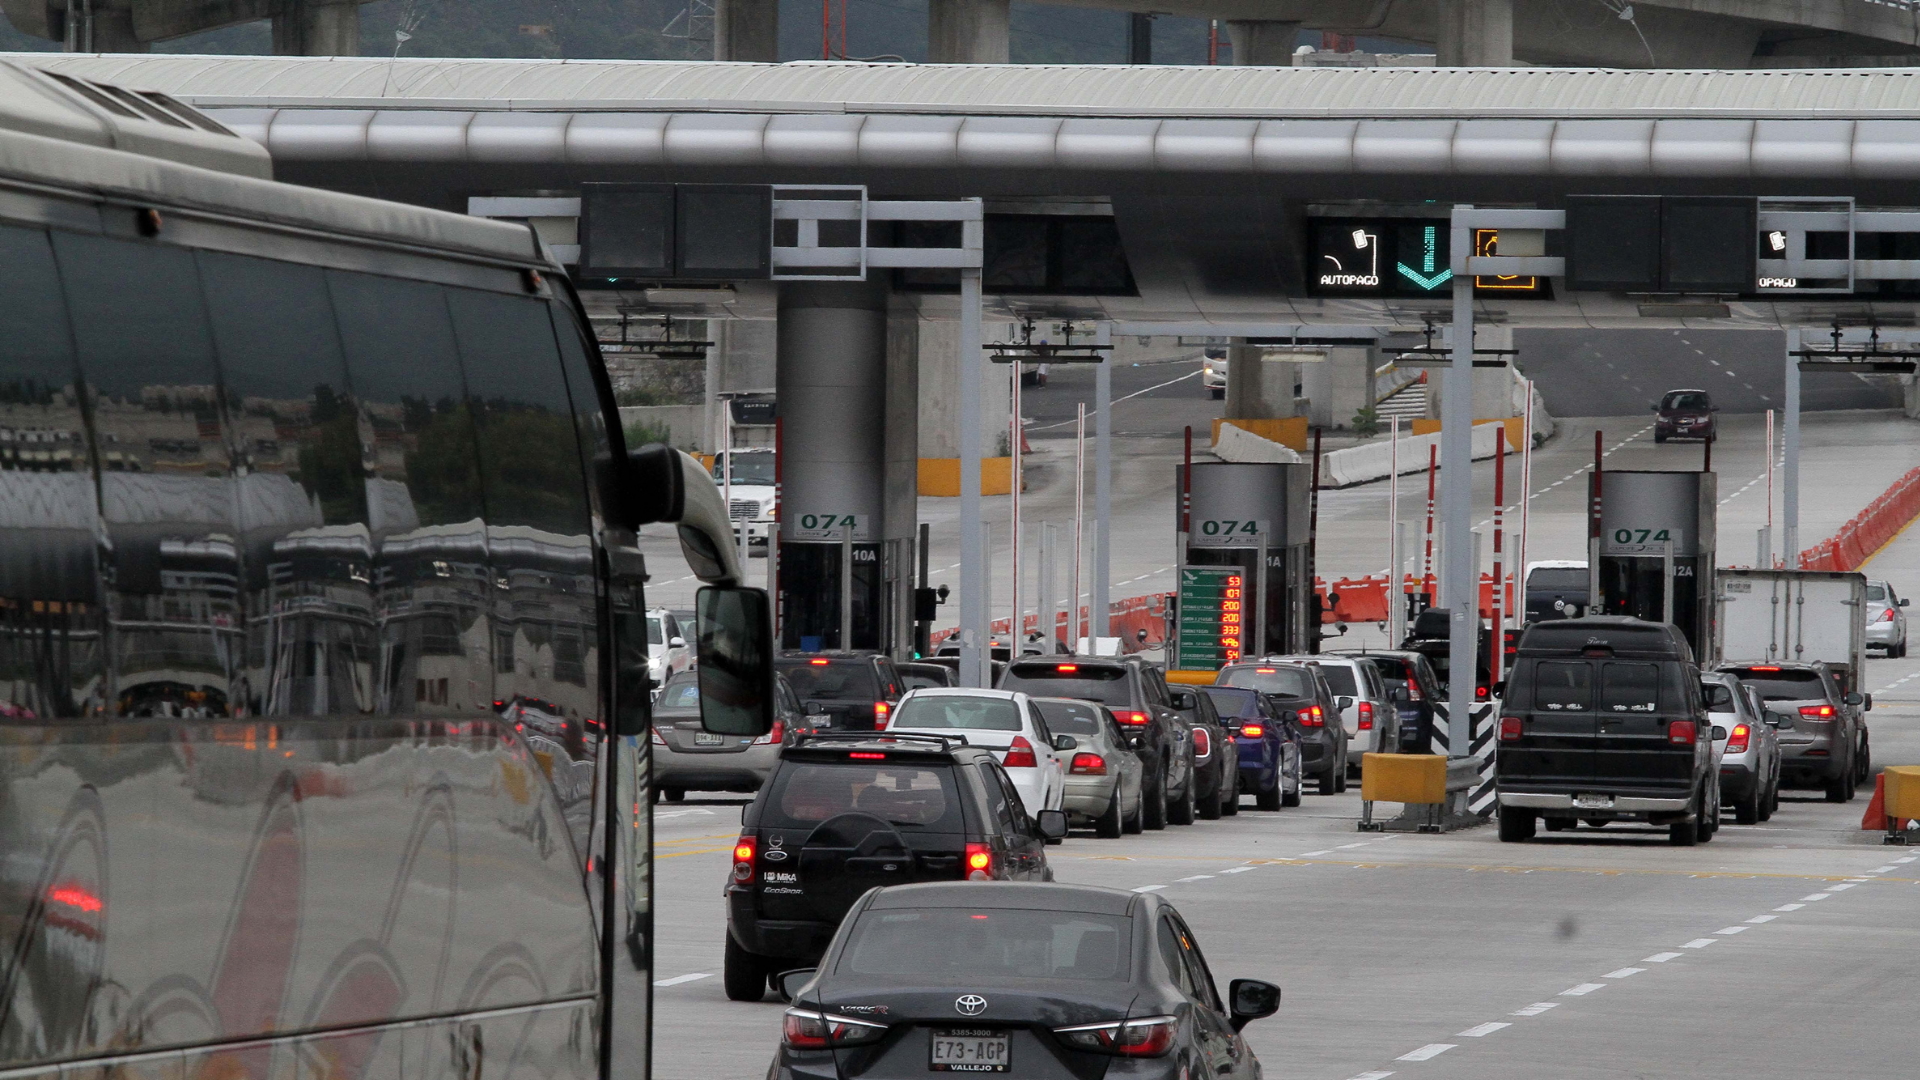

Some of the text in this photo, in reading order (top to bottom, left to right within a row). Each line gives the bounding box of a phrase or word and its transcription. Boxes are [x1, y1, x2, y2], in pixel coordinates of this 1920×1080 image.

[1320, 275, 1379, 286] AUTOPAGO
[1759, 277, 1797, 287] OPAGO
[801, 514, 857, 530] 074
[1202, 520, 1259, 535] 074
[1614, 528, 1671, 544] 074
[852, 549, 876, 561] 10A
[1266, 556, 1281, 567] 1A
[1672, 565, 1693, 577] 12A
[1228, 576, 1241, 586] 53
[1222, 601, 1240, 610] 200
[1222, 613, 1239, 623] 200
[1222, 625, 1239, 635] 333
[1226, 650, 1239, 659] 54
[935, 1041, 1005, 1060] E73-AGP
